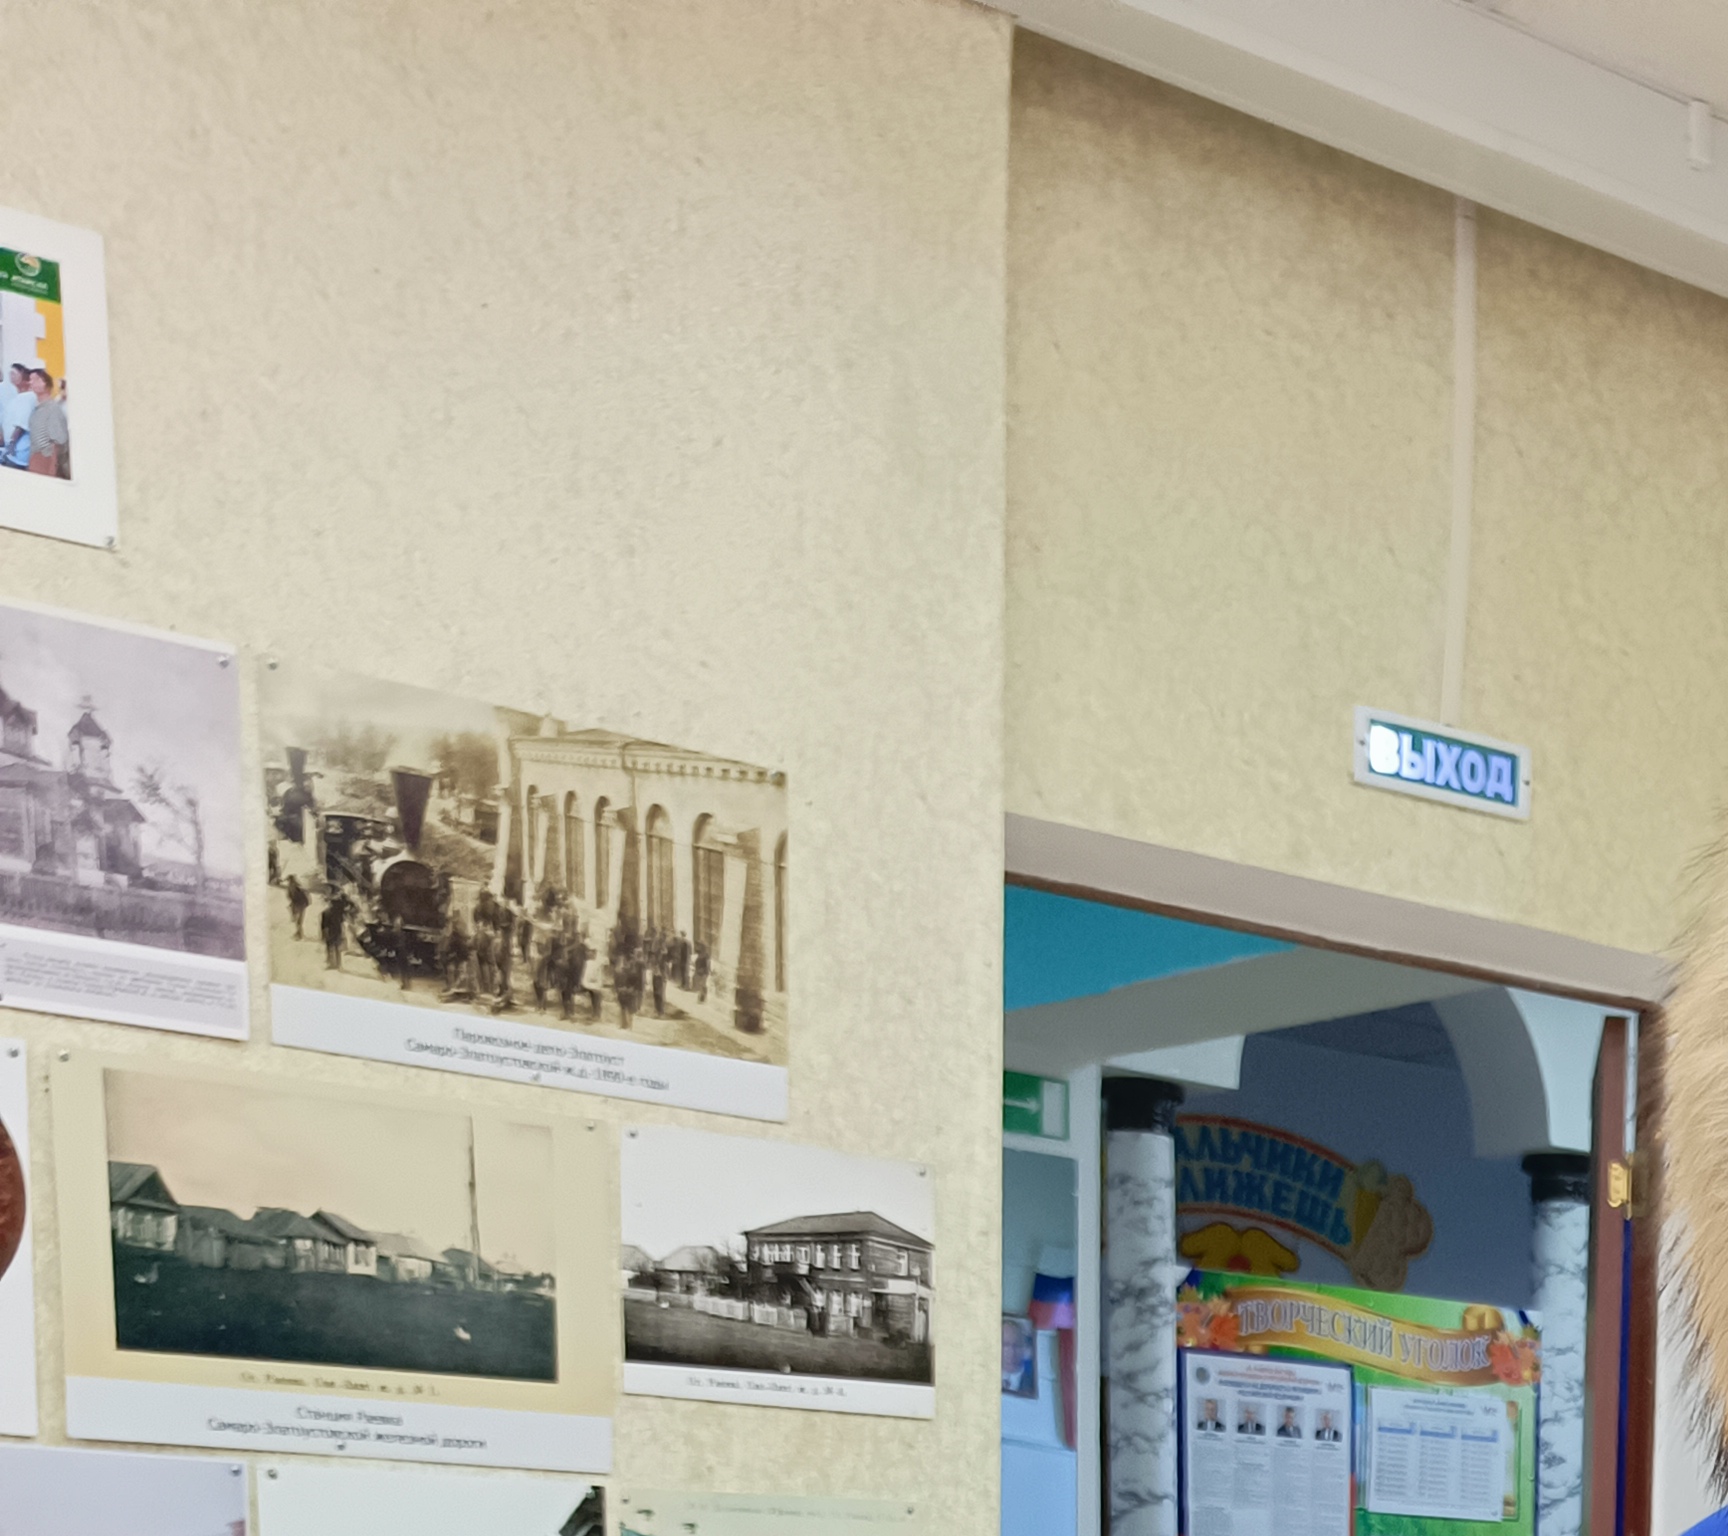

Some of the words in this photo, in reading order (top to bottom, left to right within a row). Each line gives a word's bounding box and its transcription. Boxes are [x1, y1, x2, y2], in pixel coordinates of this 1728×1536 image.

[1369, 724, 1513, 803] ВЫХОД
[1238, 1300, 1394, 1359] ТВОРЧЕСКИЙ
[1398, 1332, 1493, 1372] УГОЛОК
